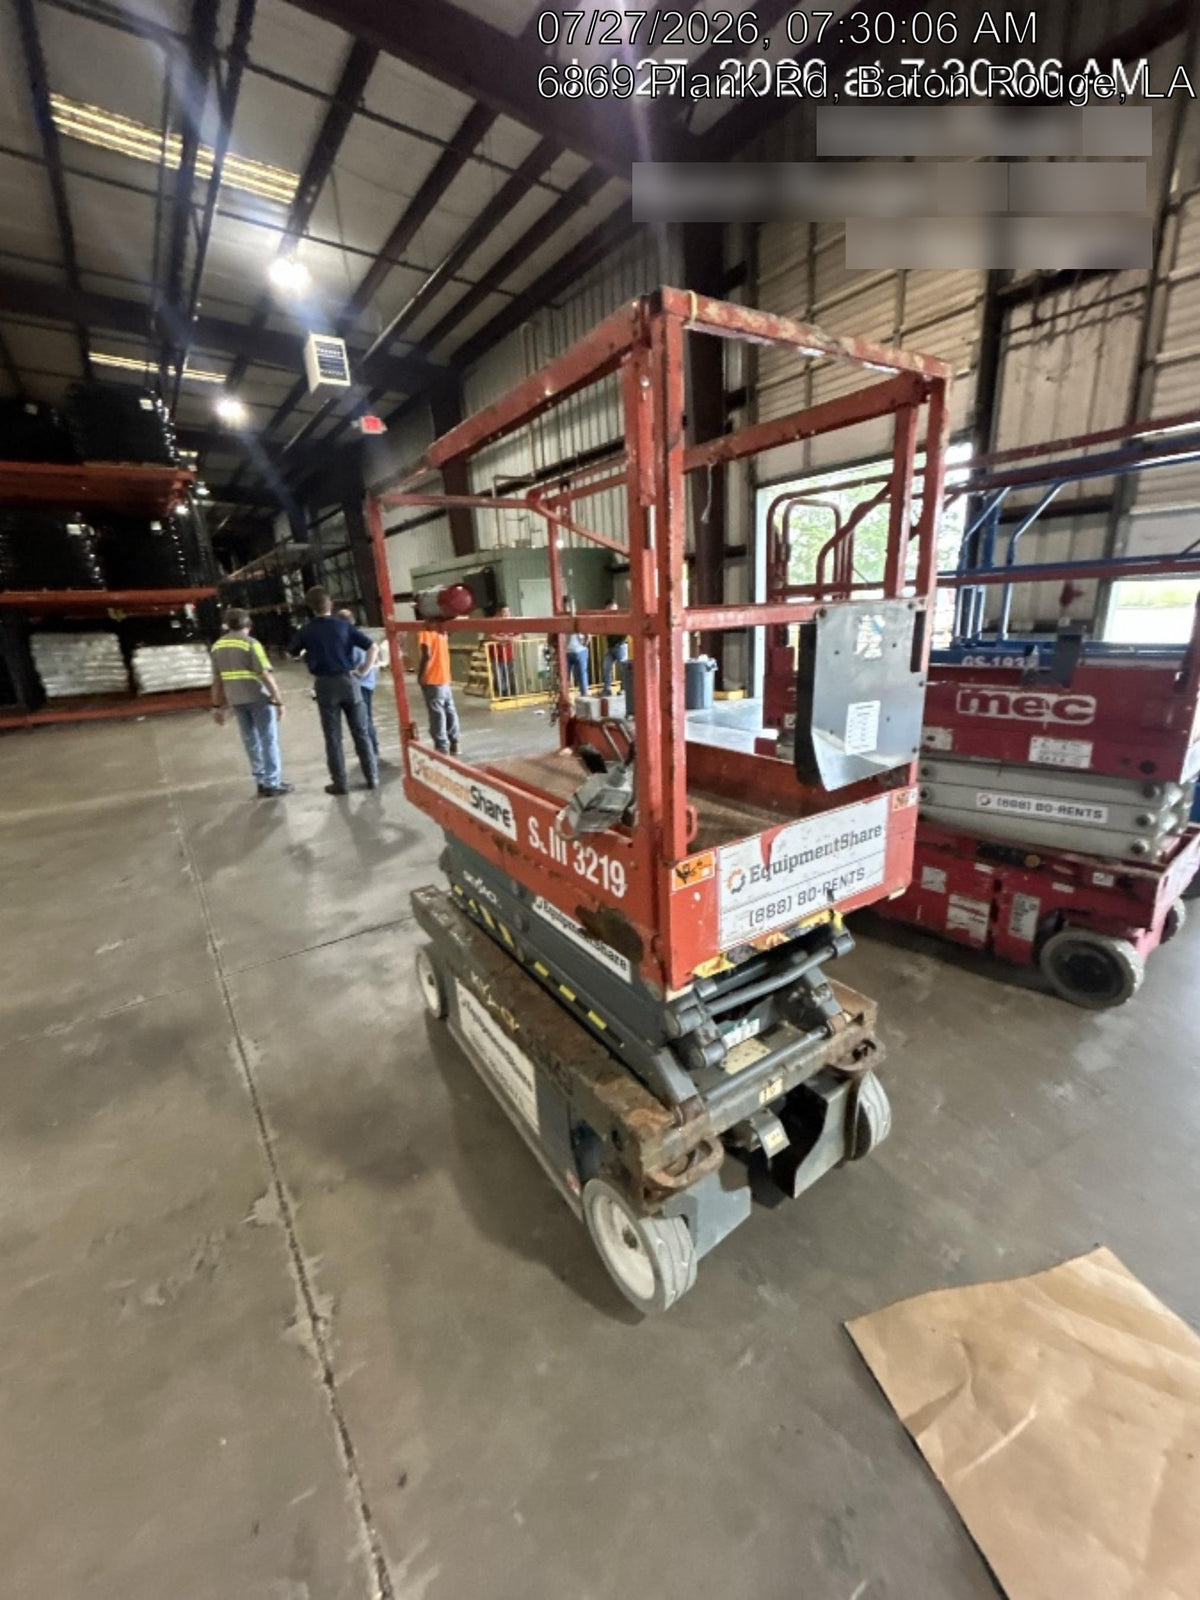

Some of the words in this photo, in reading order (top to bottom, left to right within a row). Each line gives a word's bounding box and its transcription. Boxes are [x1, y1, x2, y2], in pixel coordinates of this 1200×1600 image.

[958, 690, 1094, 722] mec
[573, 840, 627, 897] 3219
[749, 825, 883, 883] EquipmentShare
[749, 896, 792, 927] (888)
